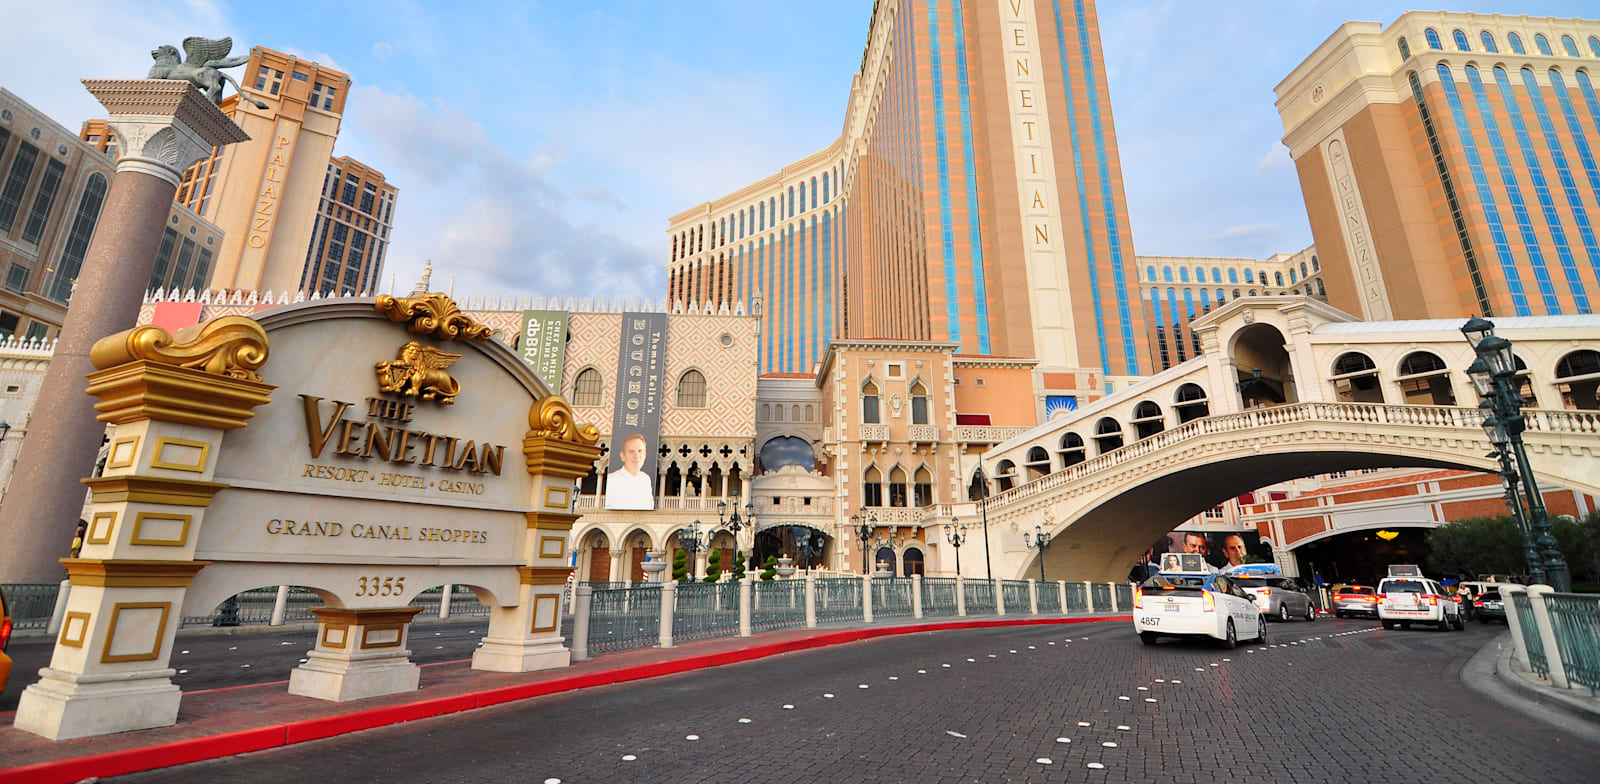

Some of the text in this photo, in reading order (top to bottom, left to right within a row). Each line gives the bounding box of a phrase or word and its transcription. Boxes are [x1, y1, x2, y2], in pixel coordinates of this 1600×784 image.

[1008, 0, 1050, 245] VENETIAN
[247, 135, 290, 249] PALAZZO
[1340, 179, 1379, 299] VENEZIA
[543, 320, 554, 358] RETURNS
[552, 320, 561, 343] CHEF
[542, 361, 549, 373] TO
[548, 346, 558, 380] DANIEL
[625, 319, 646, 427] BOUCHON
[647, 331, 661, 414] Thomas Keller's
[365, 397, 416, 423] THE
[298, 394, 507, 476] VENETIAN
[302, 463, 485, 496] RESORT HOTEL CASINO
[266, 519, 488, 544] GRAND CANAL SHOPPES
[355, 576, 406, 597] 3355
[1140, 617, 1160, 626] 4857
